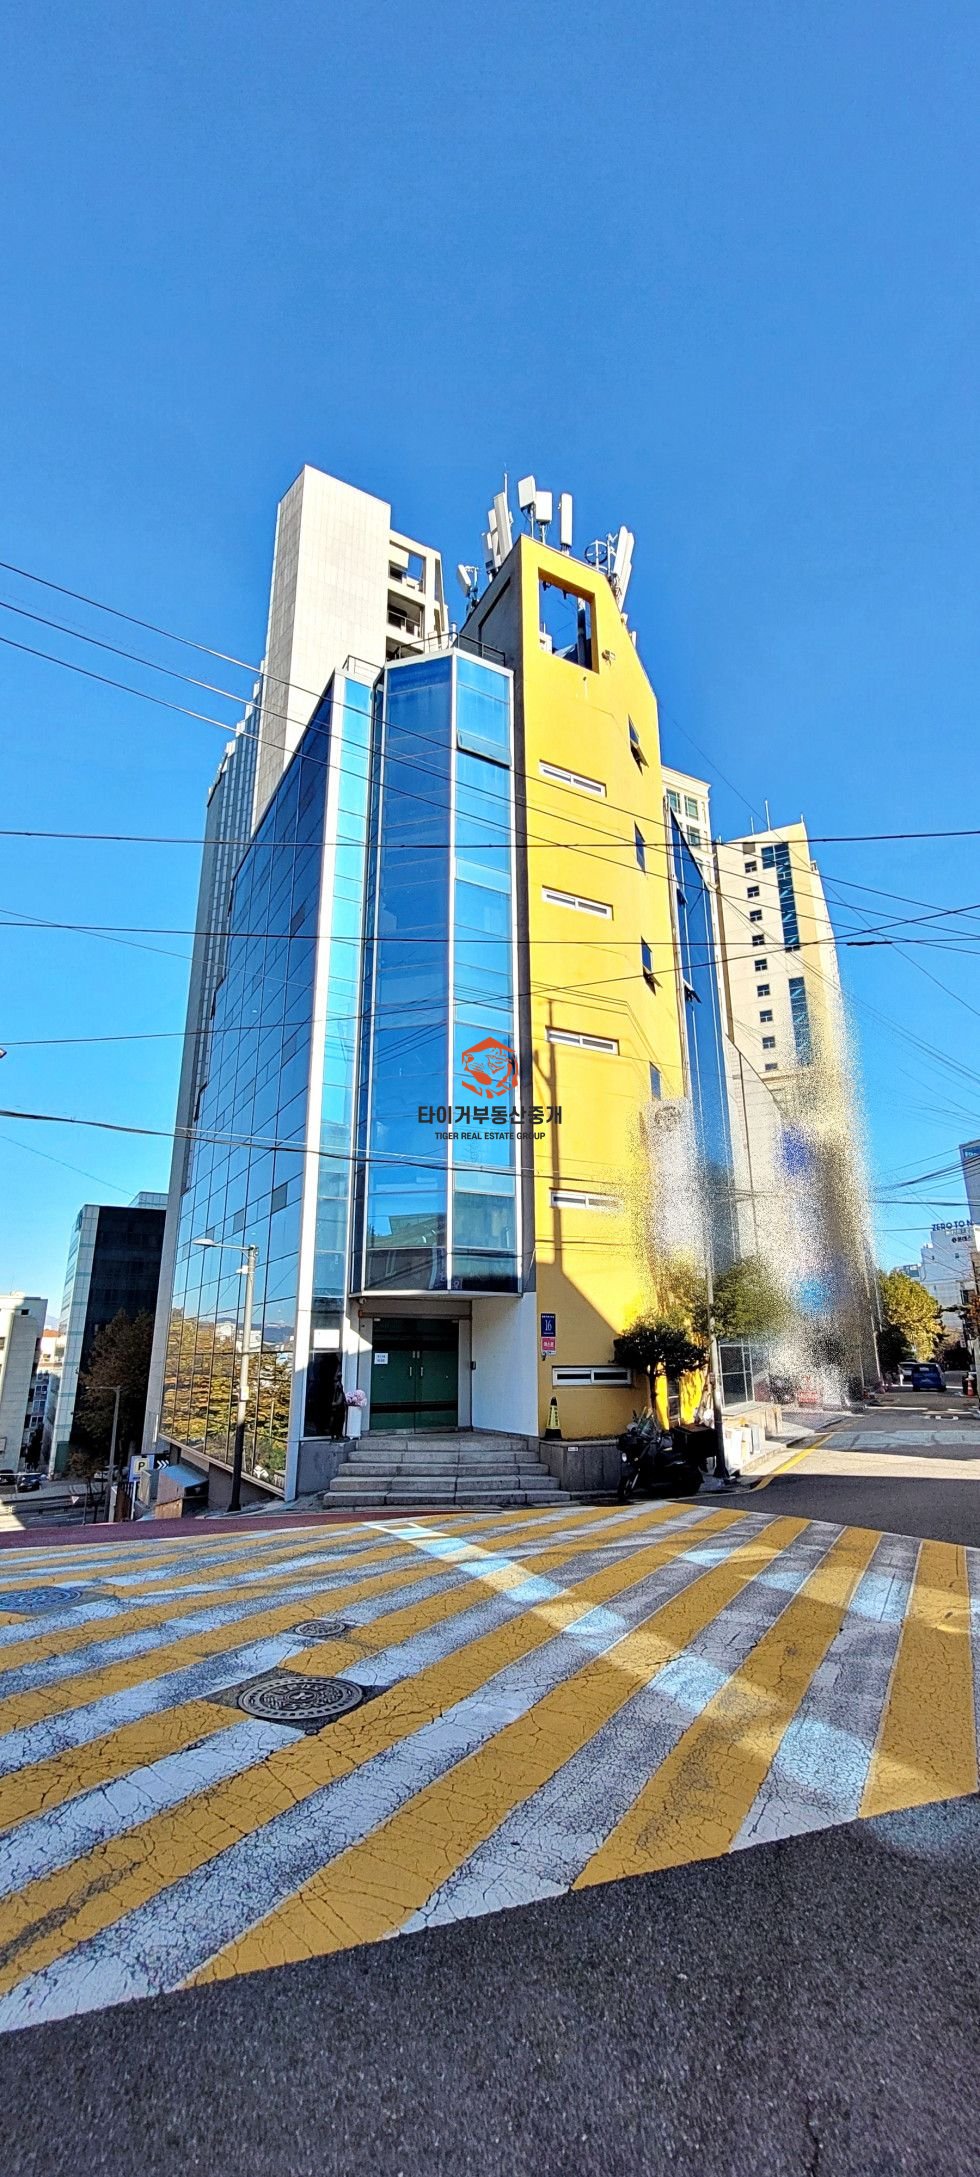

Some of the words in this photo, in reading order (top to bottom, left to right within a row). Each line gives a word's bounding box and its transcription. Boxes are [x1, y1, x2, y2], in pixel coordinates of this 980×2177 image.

[932, 1222, 952, 1231] ZERO
[954, 1220, 965, 1228] TO
[545, 1319, 552, 1331] 16
[138, 1462, 145, 1471] P
